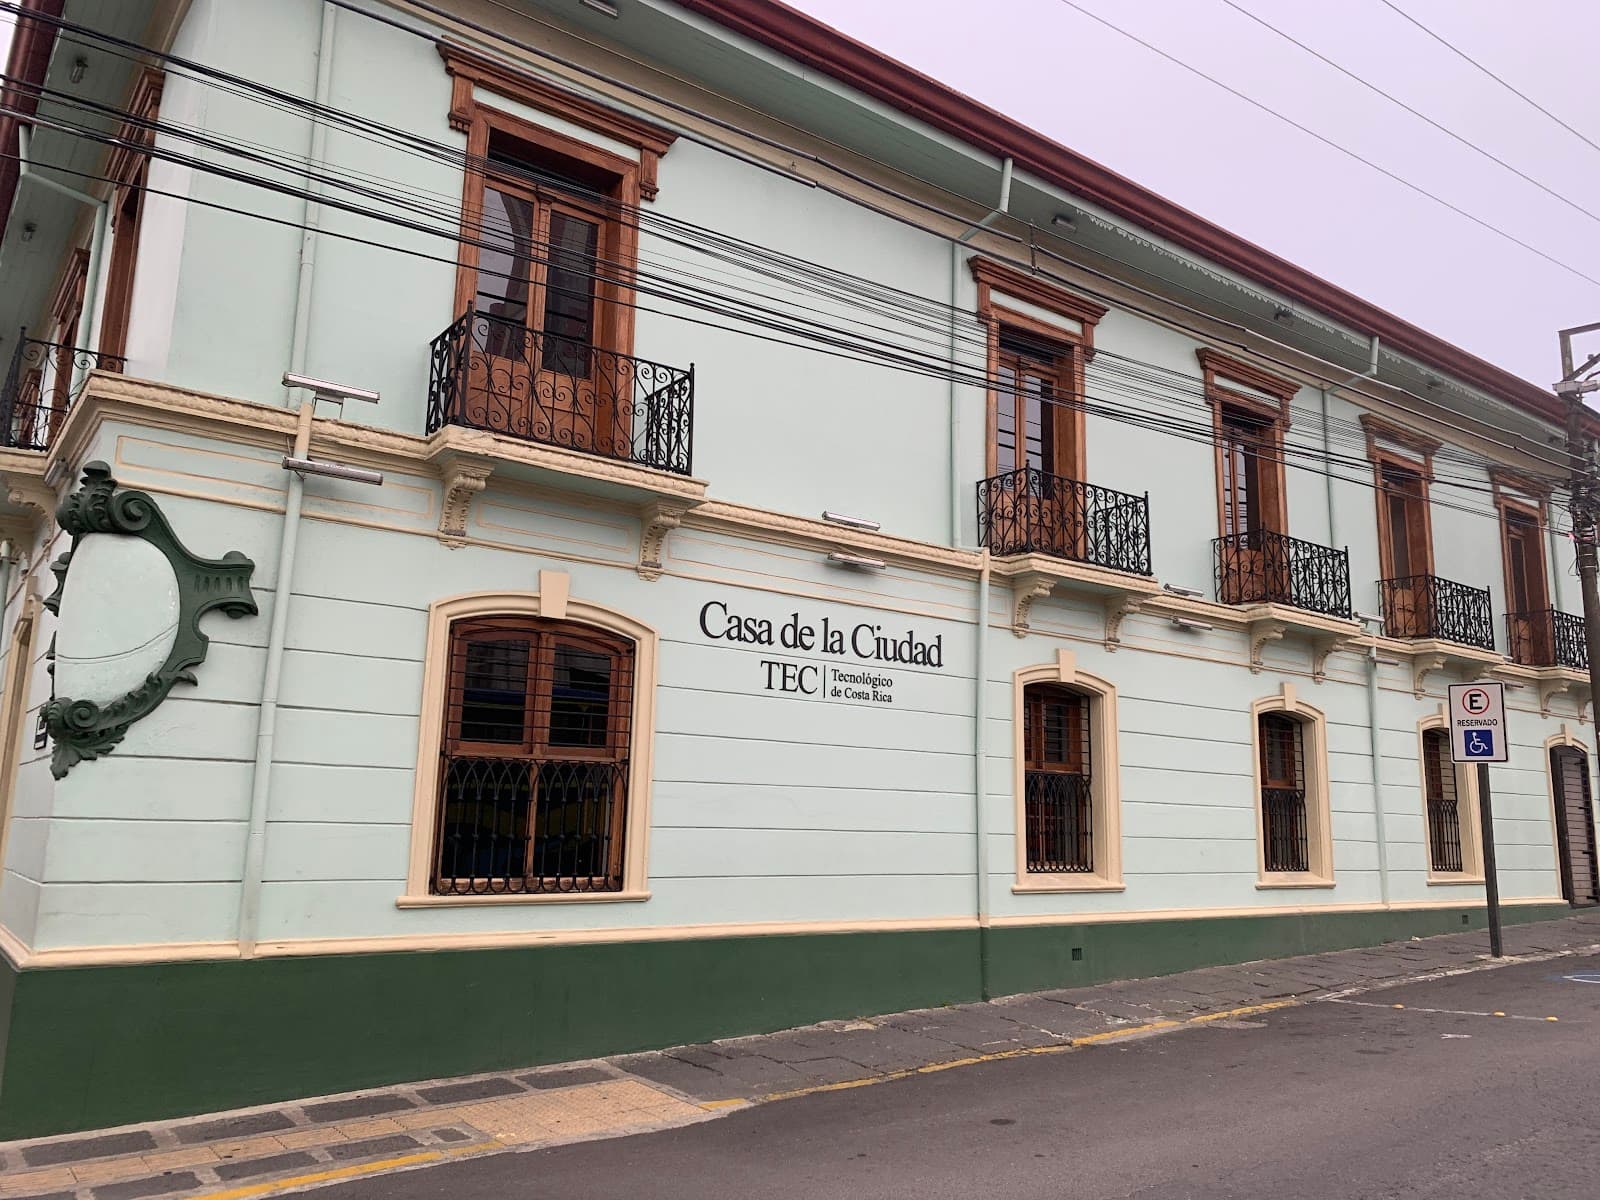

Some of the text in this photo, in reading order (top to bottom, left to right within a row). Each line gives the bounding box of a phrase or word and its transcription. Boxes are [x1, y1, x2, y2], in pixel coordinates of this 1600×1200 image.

[700, 601, 943, 668] Casa de la Ciudad
[761, 660, 818, 694] TEC
[831, 669, 893, 689] Tecnológico
[831, 686, 893, 703] de Costa Rica
[1469, 694, 1482, 710] E
[1457, 719, 1497, 727] RESERVADO
